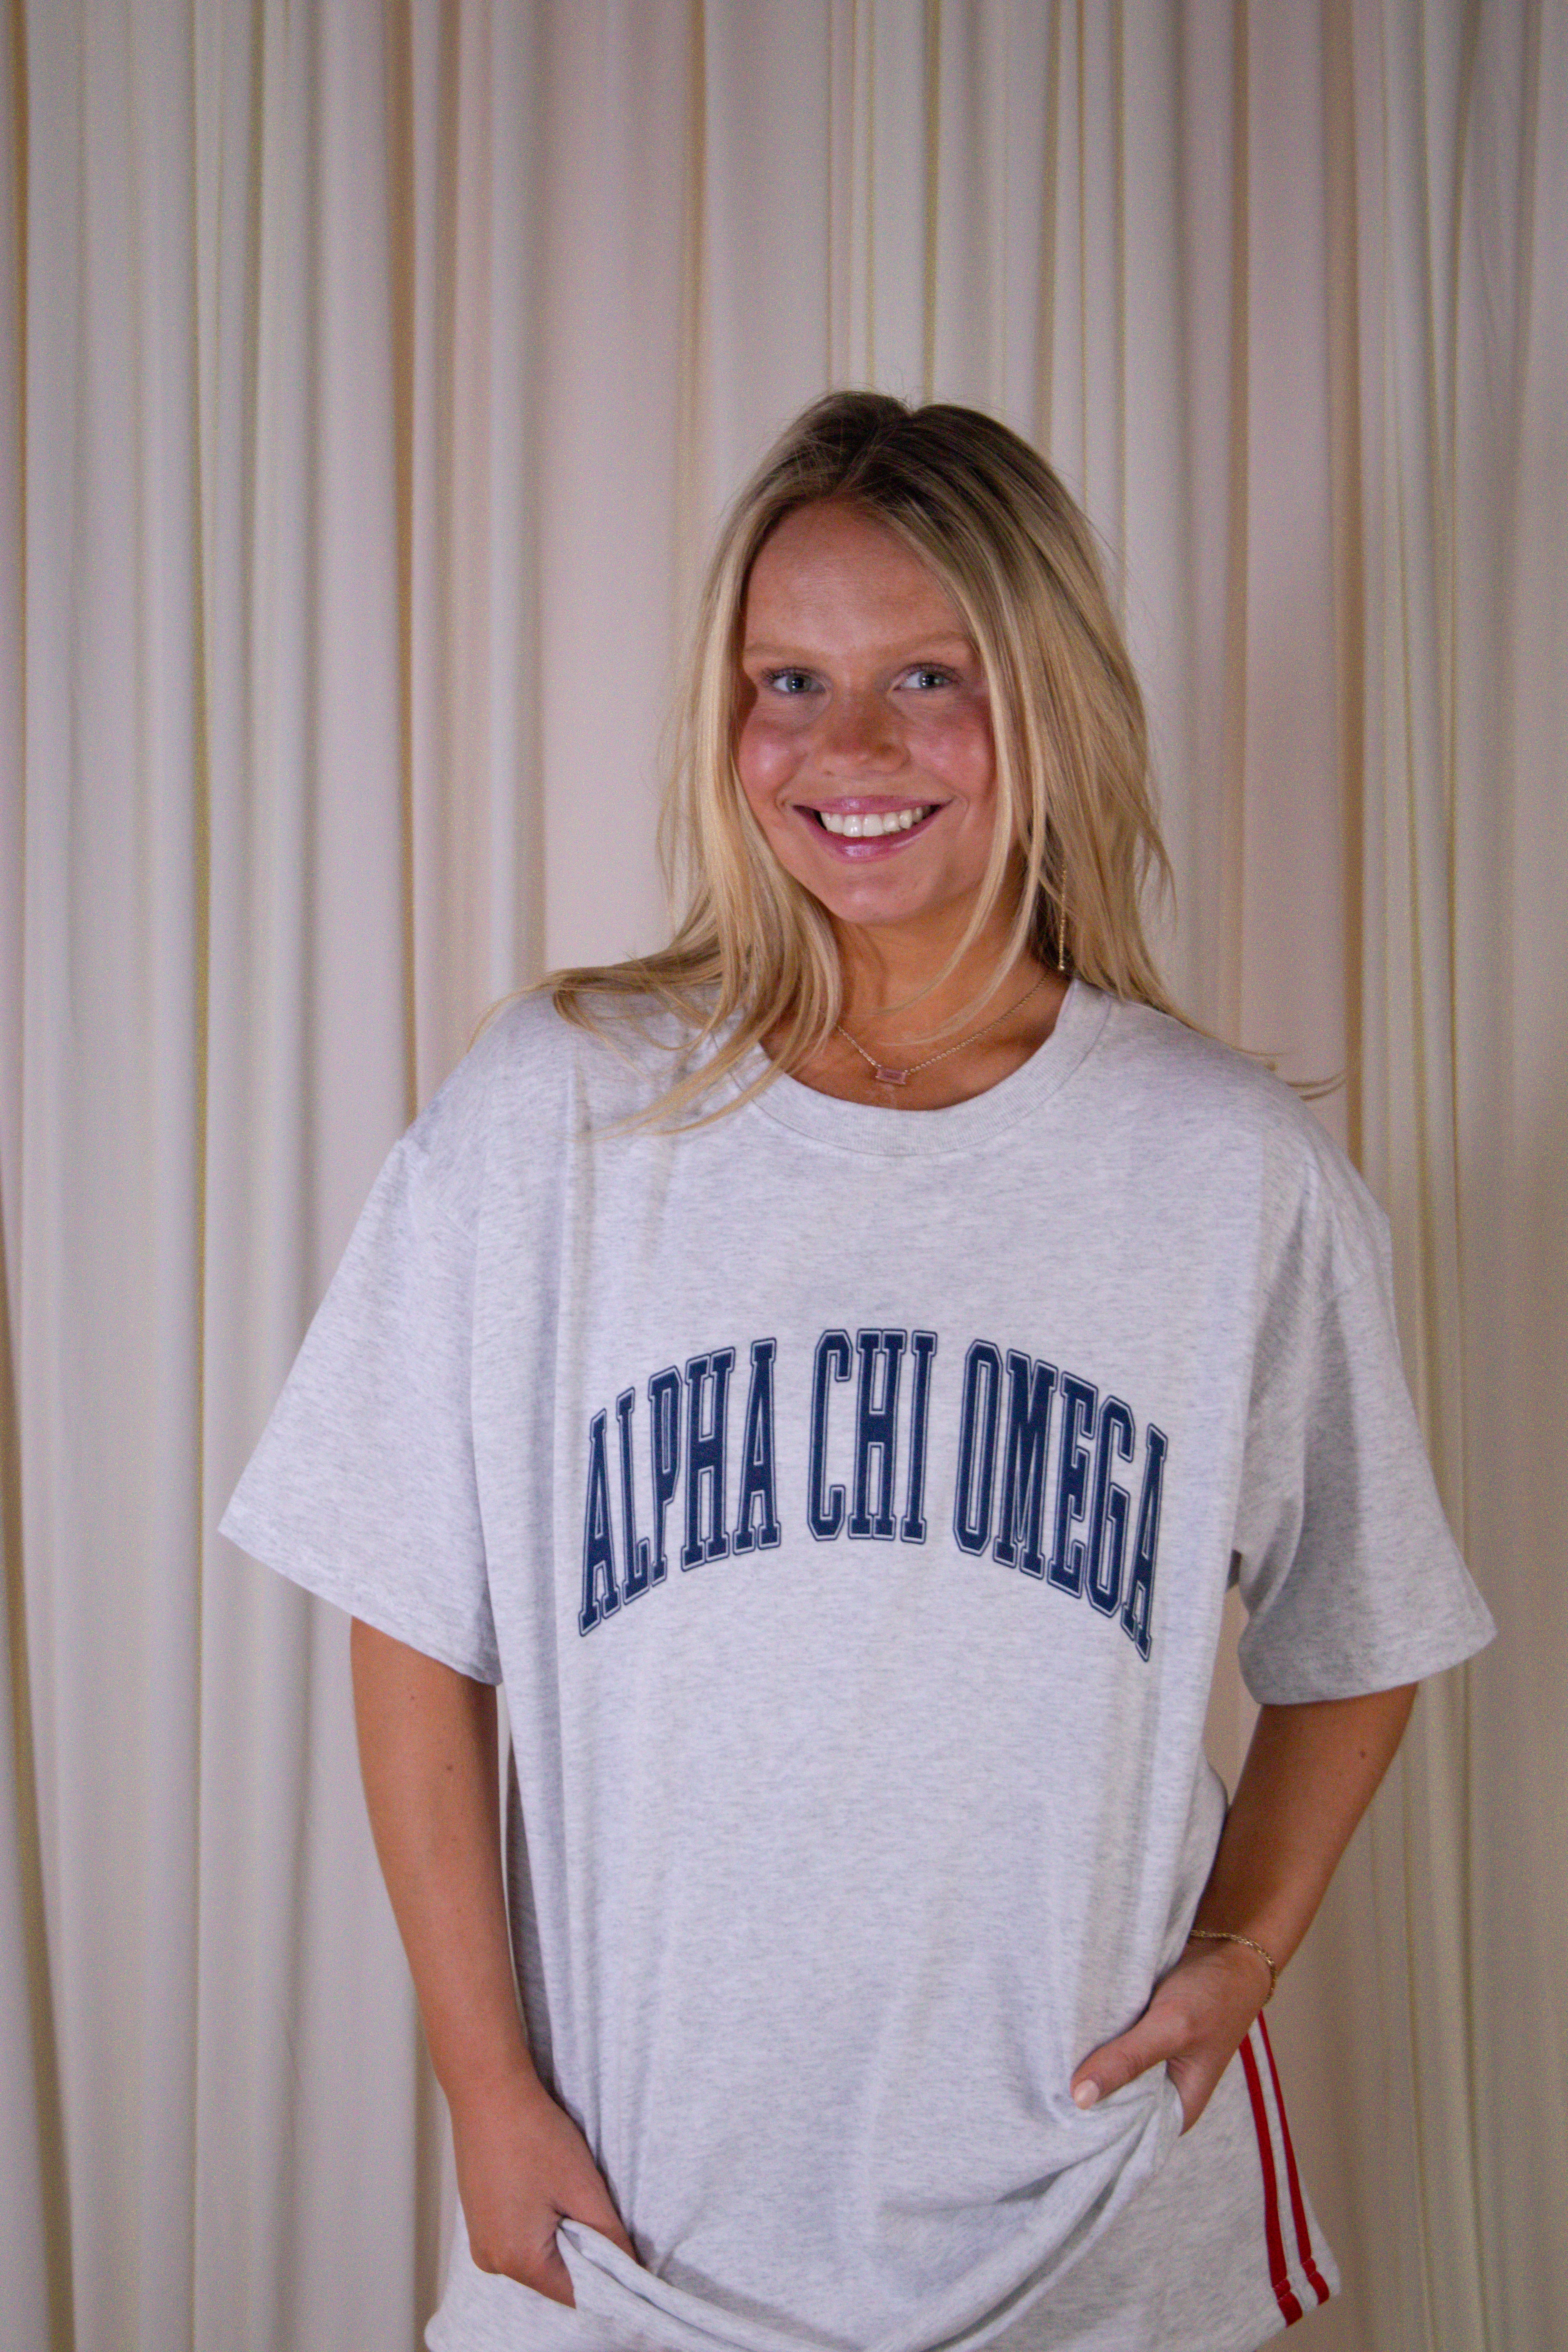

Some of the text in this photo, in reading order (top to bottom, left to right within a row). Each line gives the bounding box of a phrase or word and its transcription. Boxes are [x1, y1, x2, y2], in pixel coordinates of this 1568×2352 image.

[578, 1329, 1168, 1662] ALPHA CHI OMEGA
